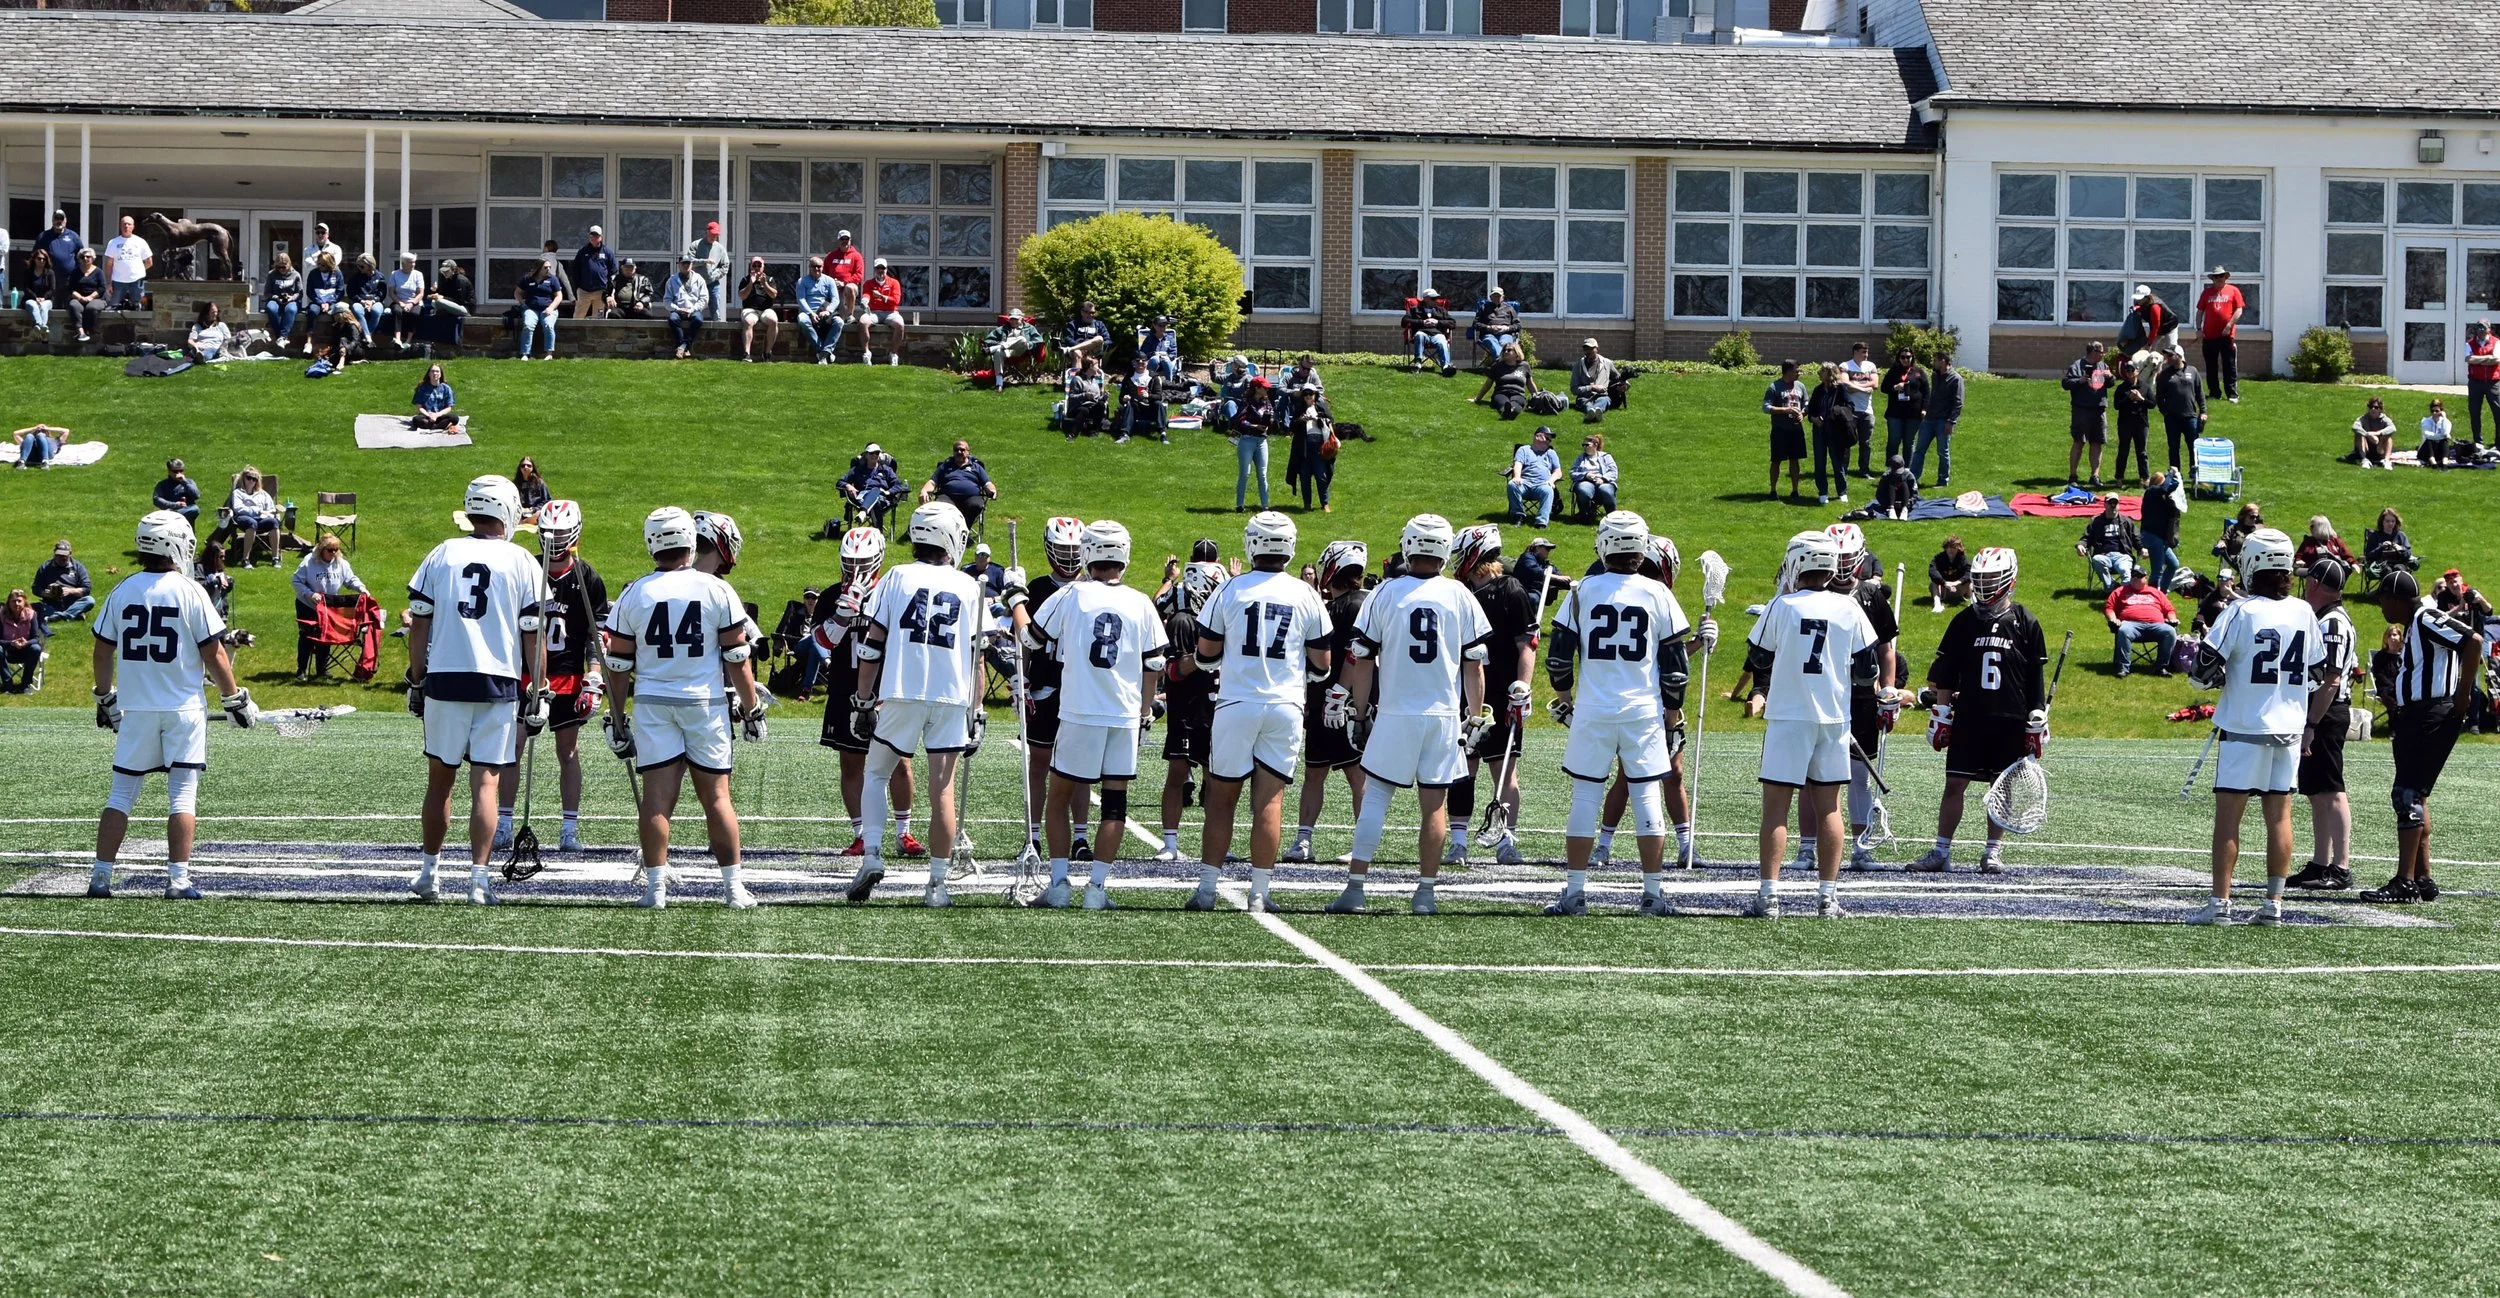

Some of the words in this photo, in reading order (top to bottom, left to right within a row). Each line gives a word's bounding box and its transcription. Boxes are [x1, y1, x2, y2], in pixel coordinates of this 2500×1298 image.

[456, 562, 491, 620] 3
[899, 587, 961, 649] 42
[121, 604, 180, 663] 25
[644, 600, 705, 658] 44
[1088, 612, 1123, 670] 8
[1241, 601, 1293, 660] 17
[1408, 607, 1438, 664] 9
[1587, 603, 1649, 662] 23
[1799, 618, 1828, 675] 7
[1974, 636, 2013, 650] CATHOLIC
[2250, 628, 2306, 686] 24
[1980, 651, 2001, 691] 6
